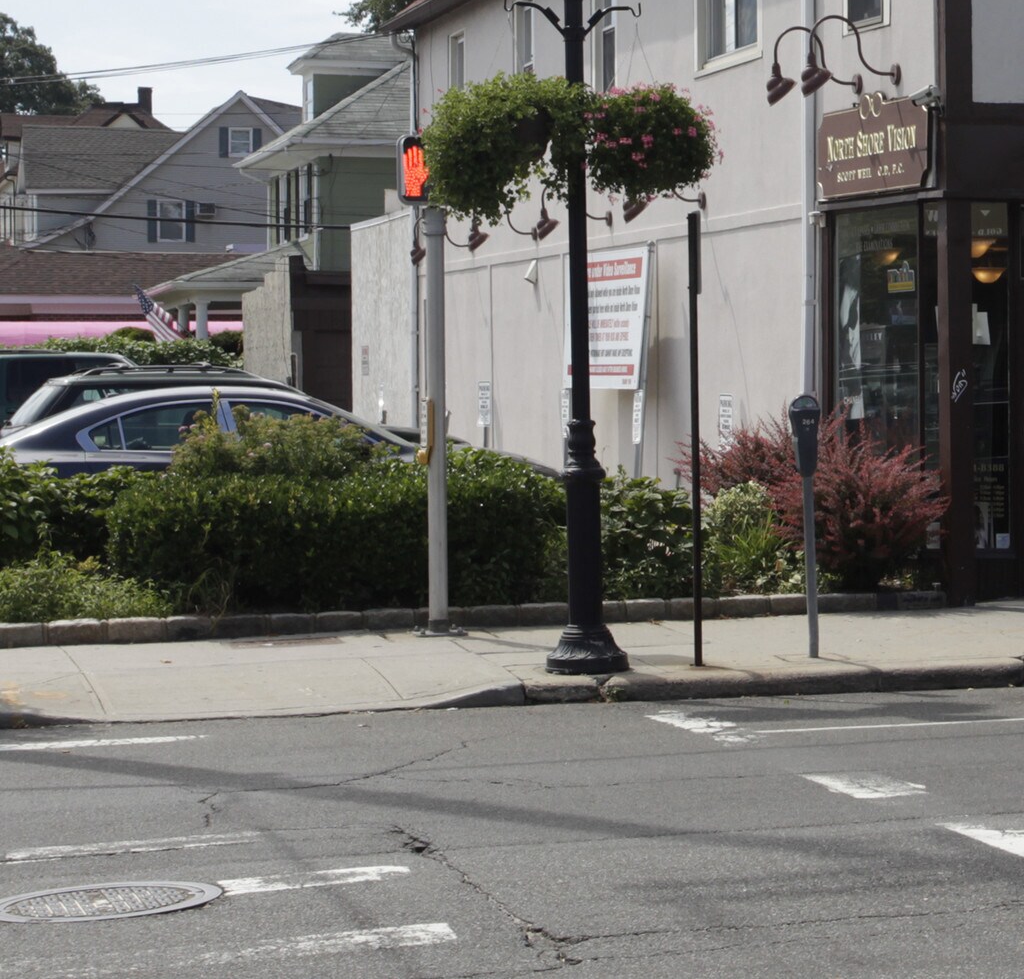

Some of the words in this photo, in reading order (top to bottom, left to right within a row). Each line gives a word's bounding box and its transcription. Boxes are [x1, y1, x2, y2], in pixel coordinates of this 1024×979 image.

[826, 135, 855, 163] NORTH
[856, 129, 885, 158] SHORE
[886, 124, 917, 152] VISION
